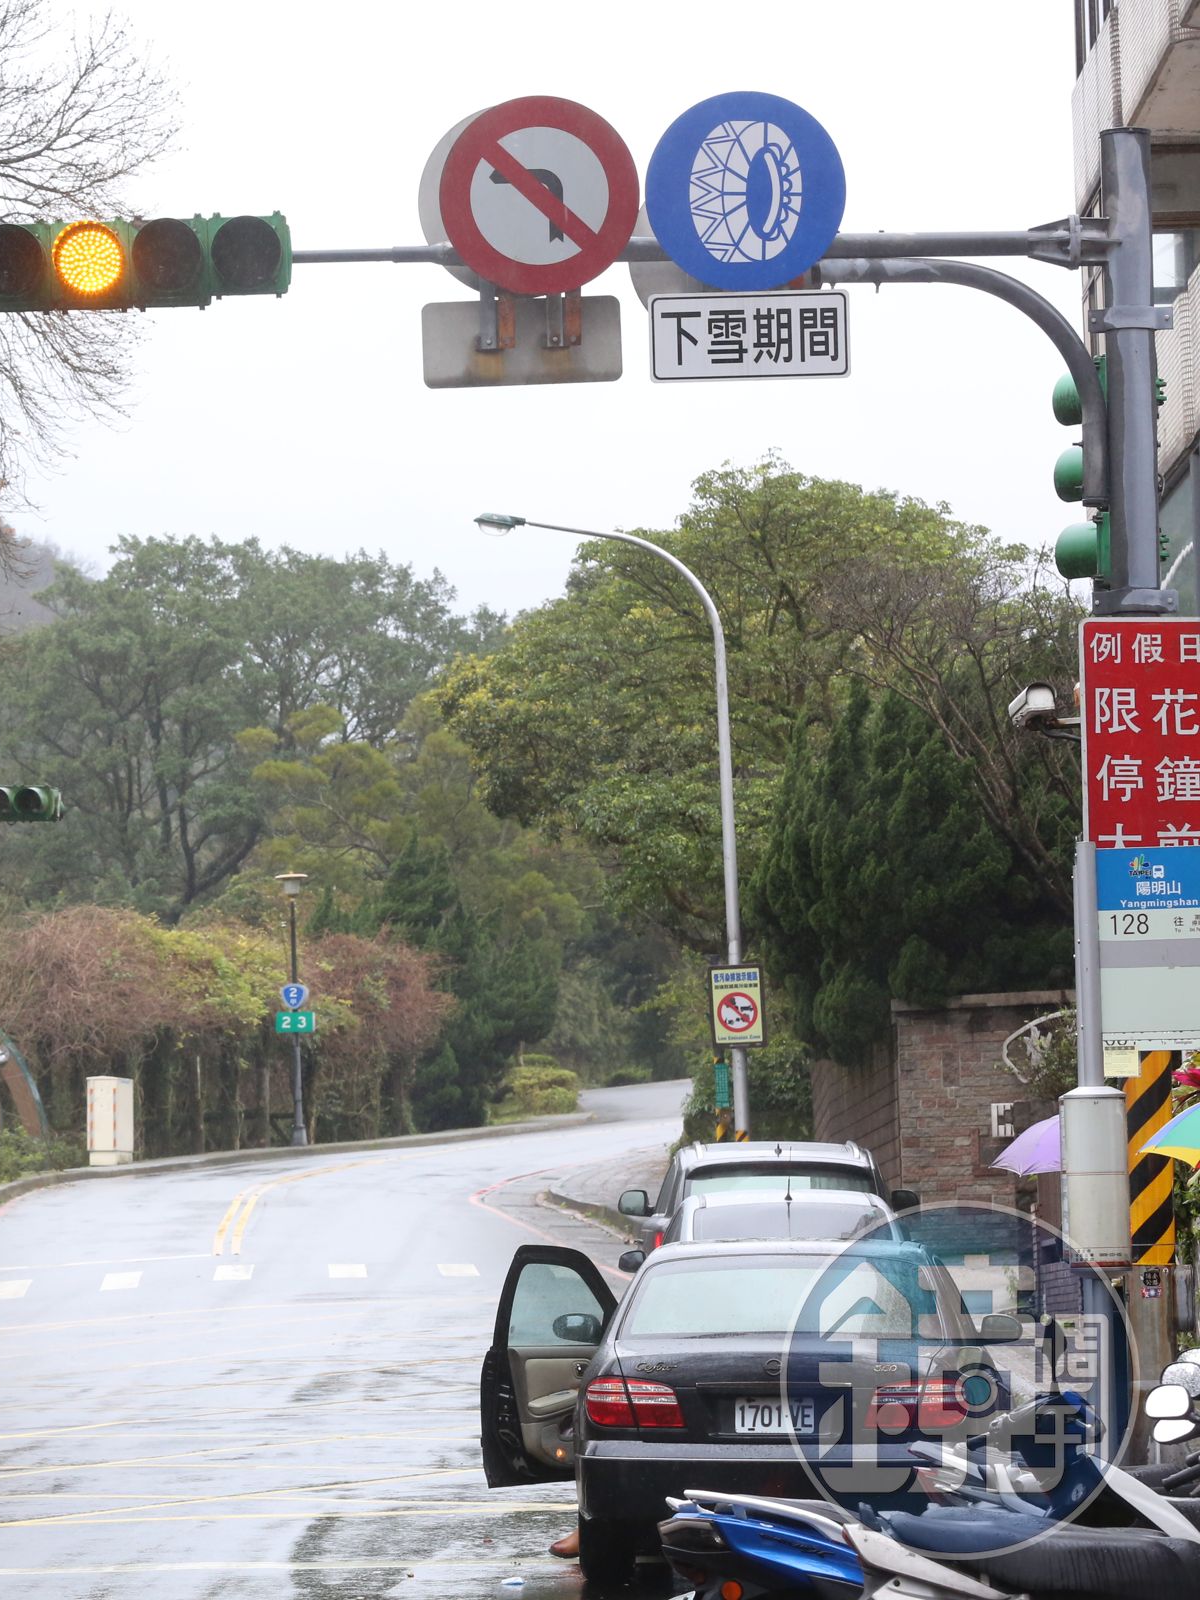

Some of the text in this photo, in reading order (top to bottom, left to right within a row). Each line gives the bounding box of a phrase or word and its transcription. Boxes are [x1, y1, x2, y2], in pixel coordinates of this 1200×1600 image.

[660, 307, 840, 367] 下雪期間
[1089, 632, 1200, 664] 例假日
[1135, 880, 1182, 896] 陽明山
[1120, 898, 1199, 909] Yangmingshan
[1110, 913, 1149, 936] 128
[1173, 916, 1184, 927] 往
[289, 987, 298, 998] 2
